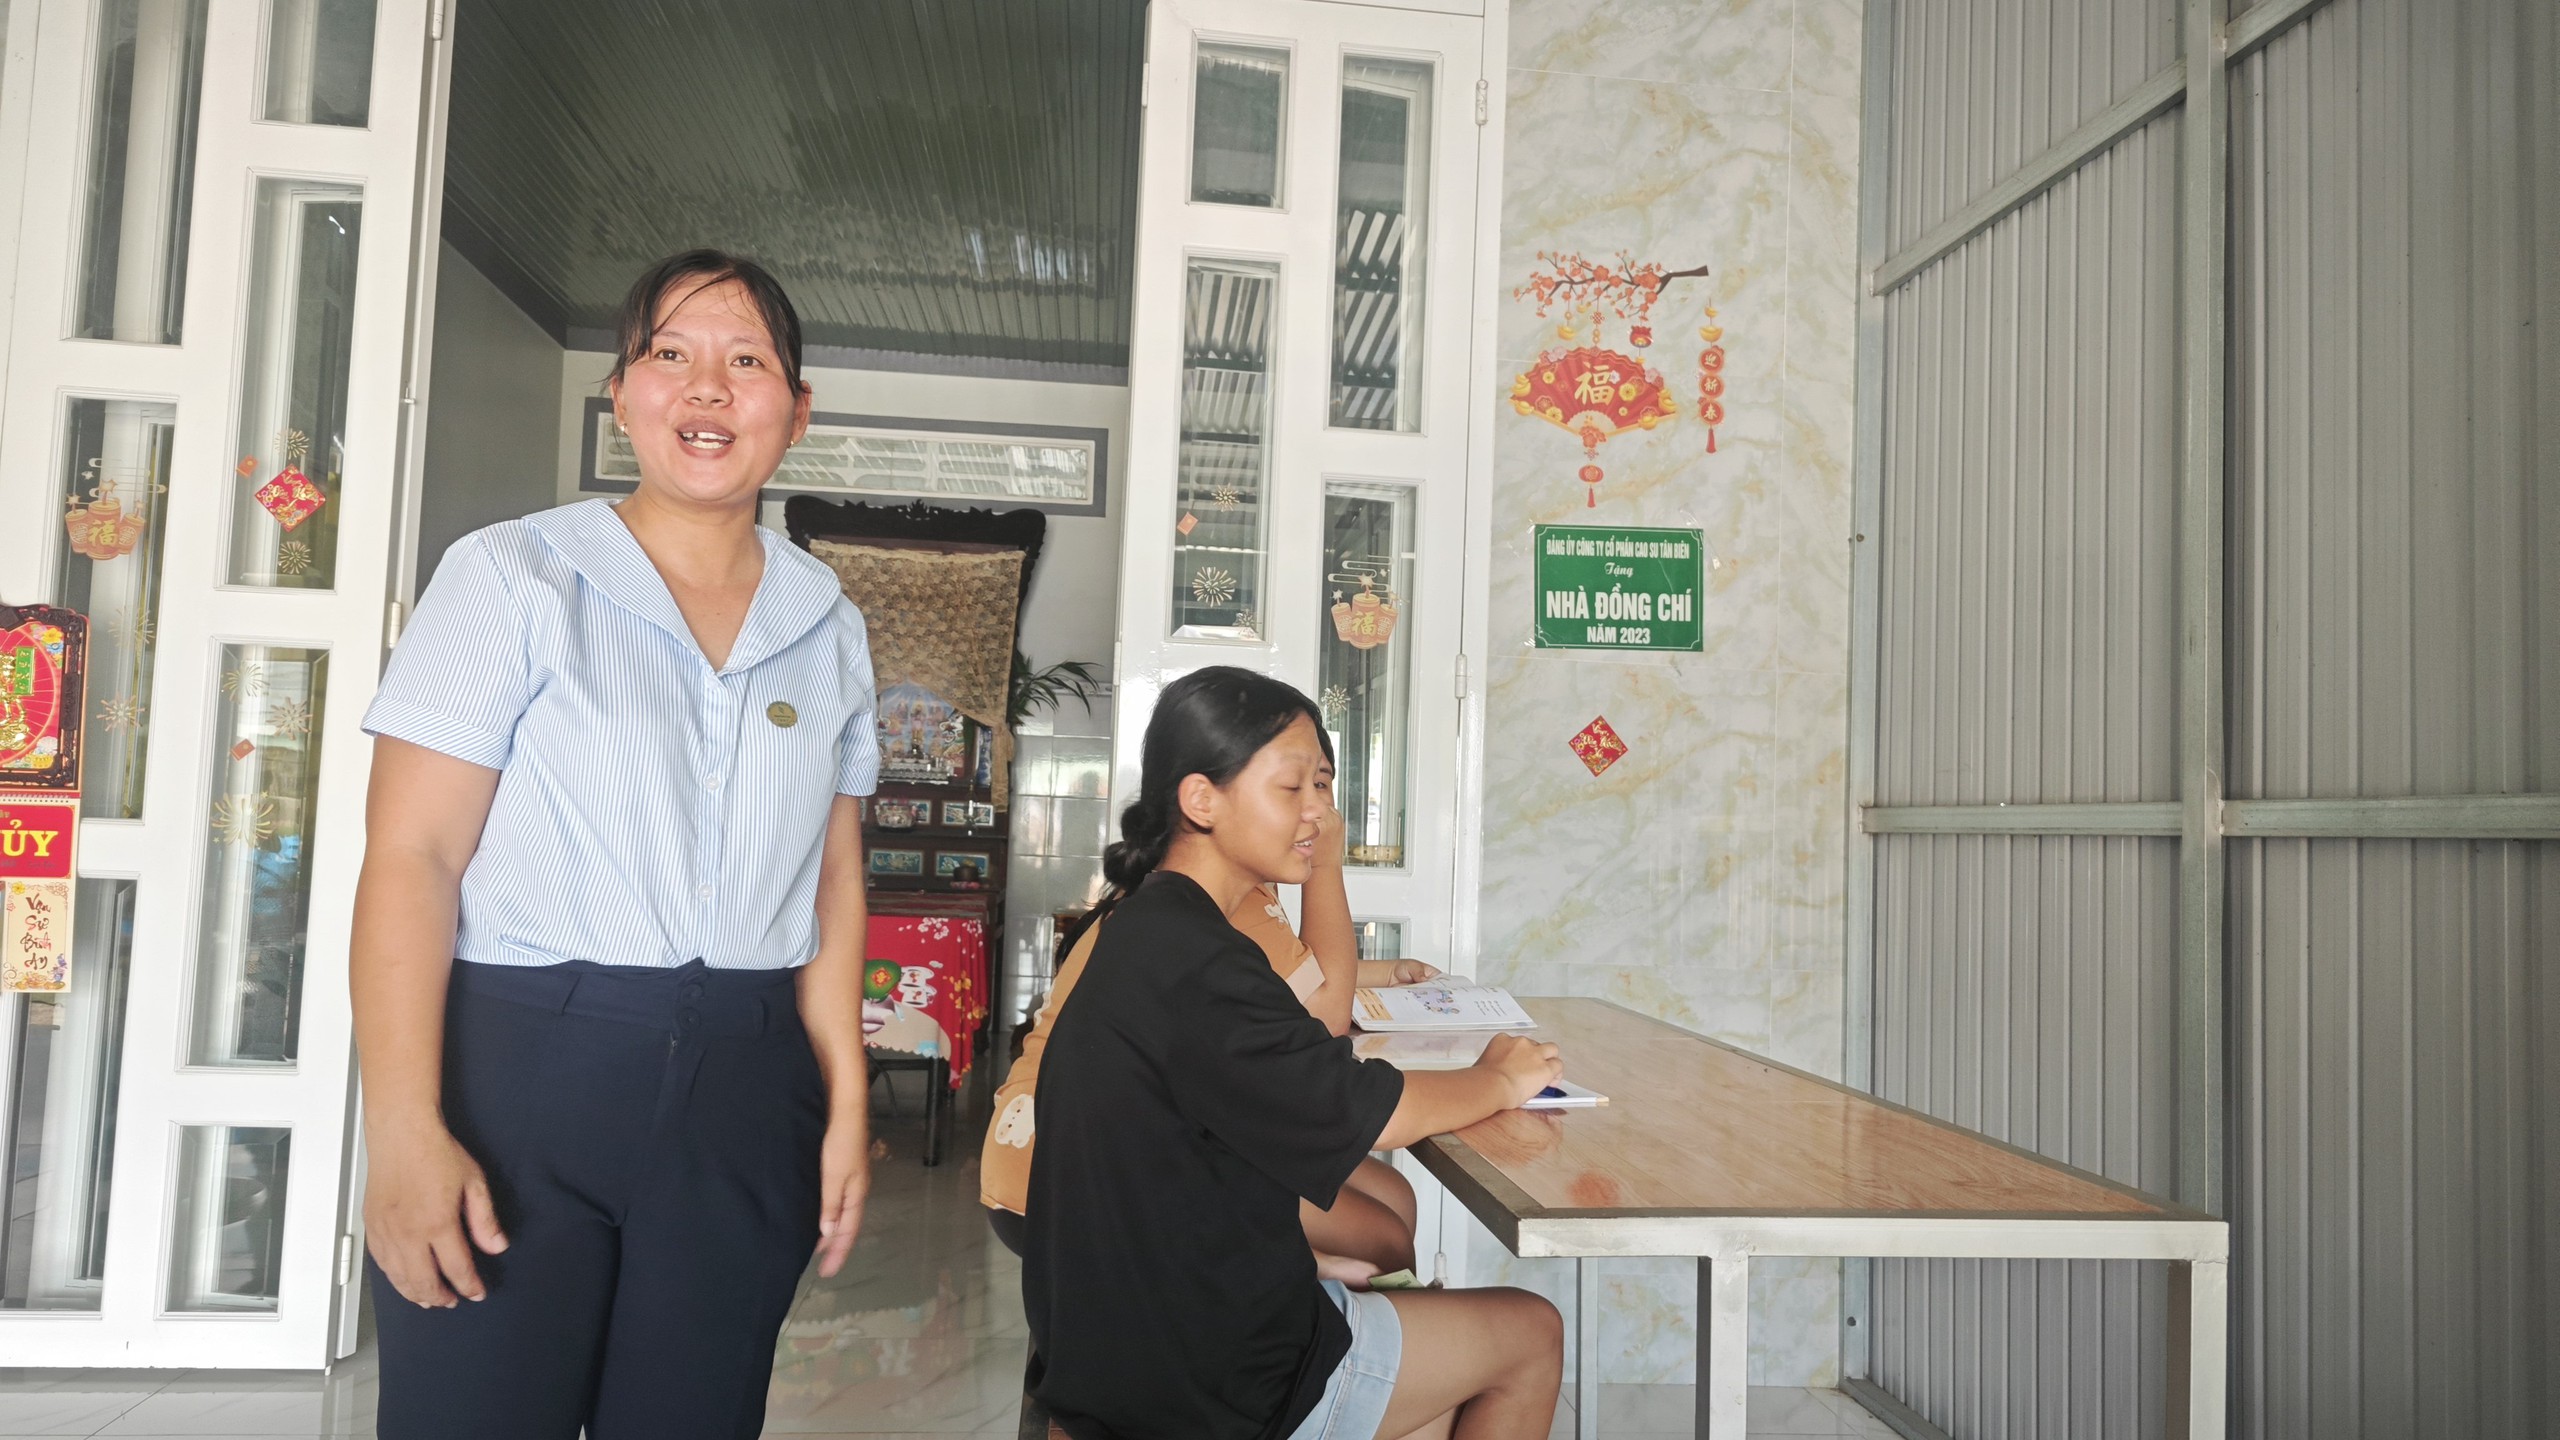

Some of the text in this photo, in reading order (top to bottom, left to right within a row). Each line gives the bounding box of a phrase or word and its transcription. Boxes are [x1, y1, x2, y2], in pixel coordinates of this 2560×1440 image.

[1574, 361, 1615, 406] 福
[87, 518, 118, 547] 福
[1546, 534, 1690, 559] ĐẢNG ỦY CÔNG TY CỔ PHẦN CAO SU TÂN BIÊN
[1604, 562, 1634, 578] Tặng
[1546, 583, 1692, 622] NHÀ ĐỒNG CHÍ
[1350, 610, 1378, 637] 福
[1586, 623, 1651, 645] NĂM 2023
[0, 818, 59, 857] ỦY
